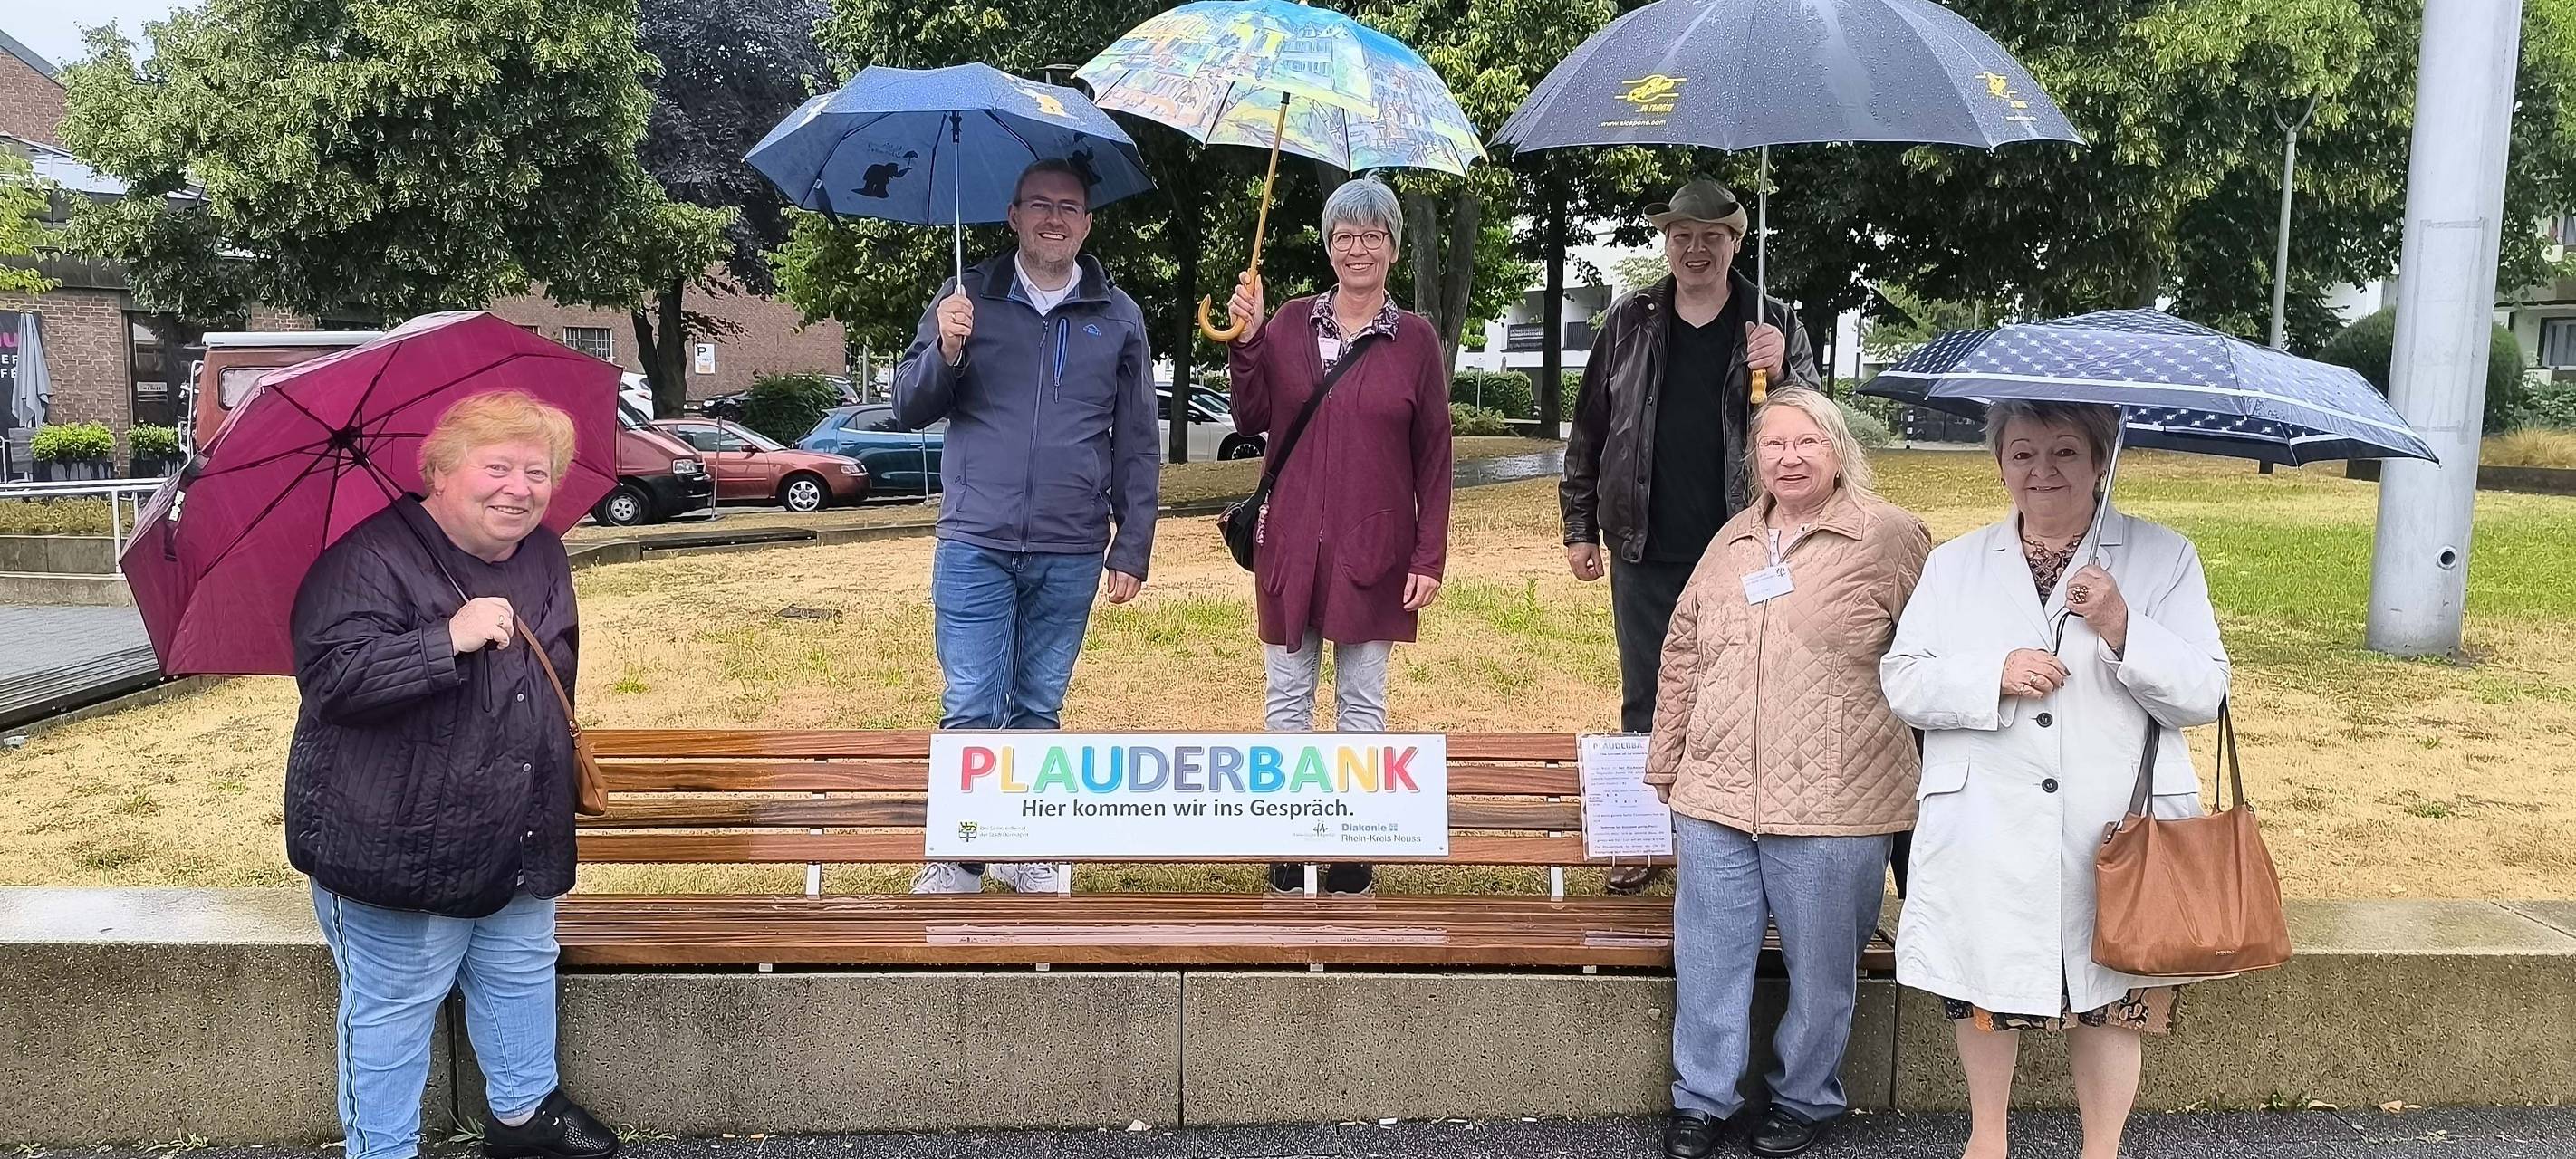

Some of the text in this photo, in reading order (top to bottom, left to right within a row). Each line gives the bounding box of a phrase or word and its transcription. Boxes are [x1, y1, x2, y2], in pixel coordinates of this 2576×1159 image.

[697, 347, 706, 356] P
[960, 745, 1421, 793] PLAUDERBANK
[1022, 798, 1355, 820] Hier kommen wir ins Gespräch.
[1341, 822, 1388, 832] Diakonie
[1341, 833, 1392, 843] Rhein-Kreis
